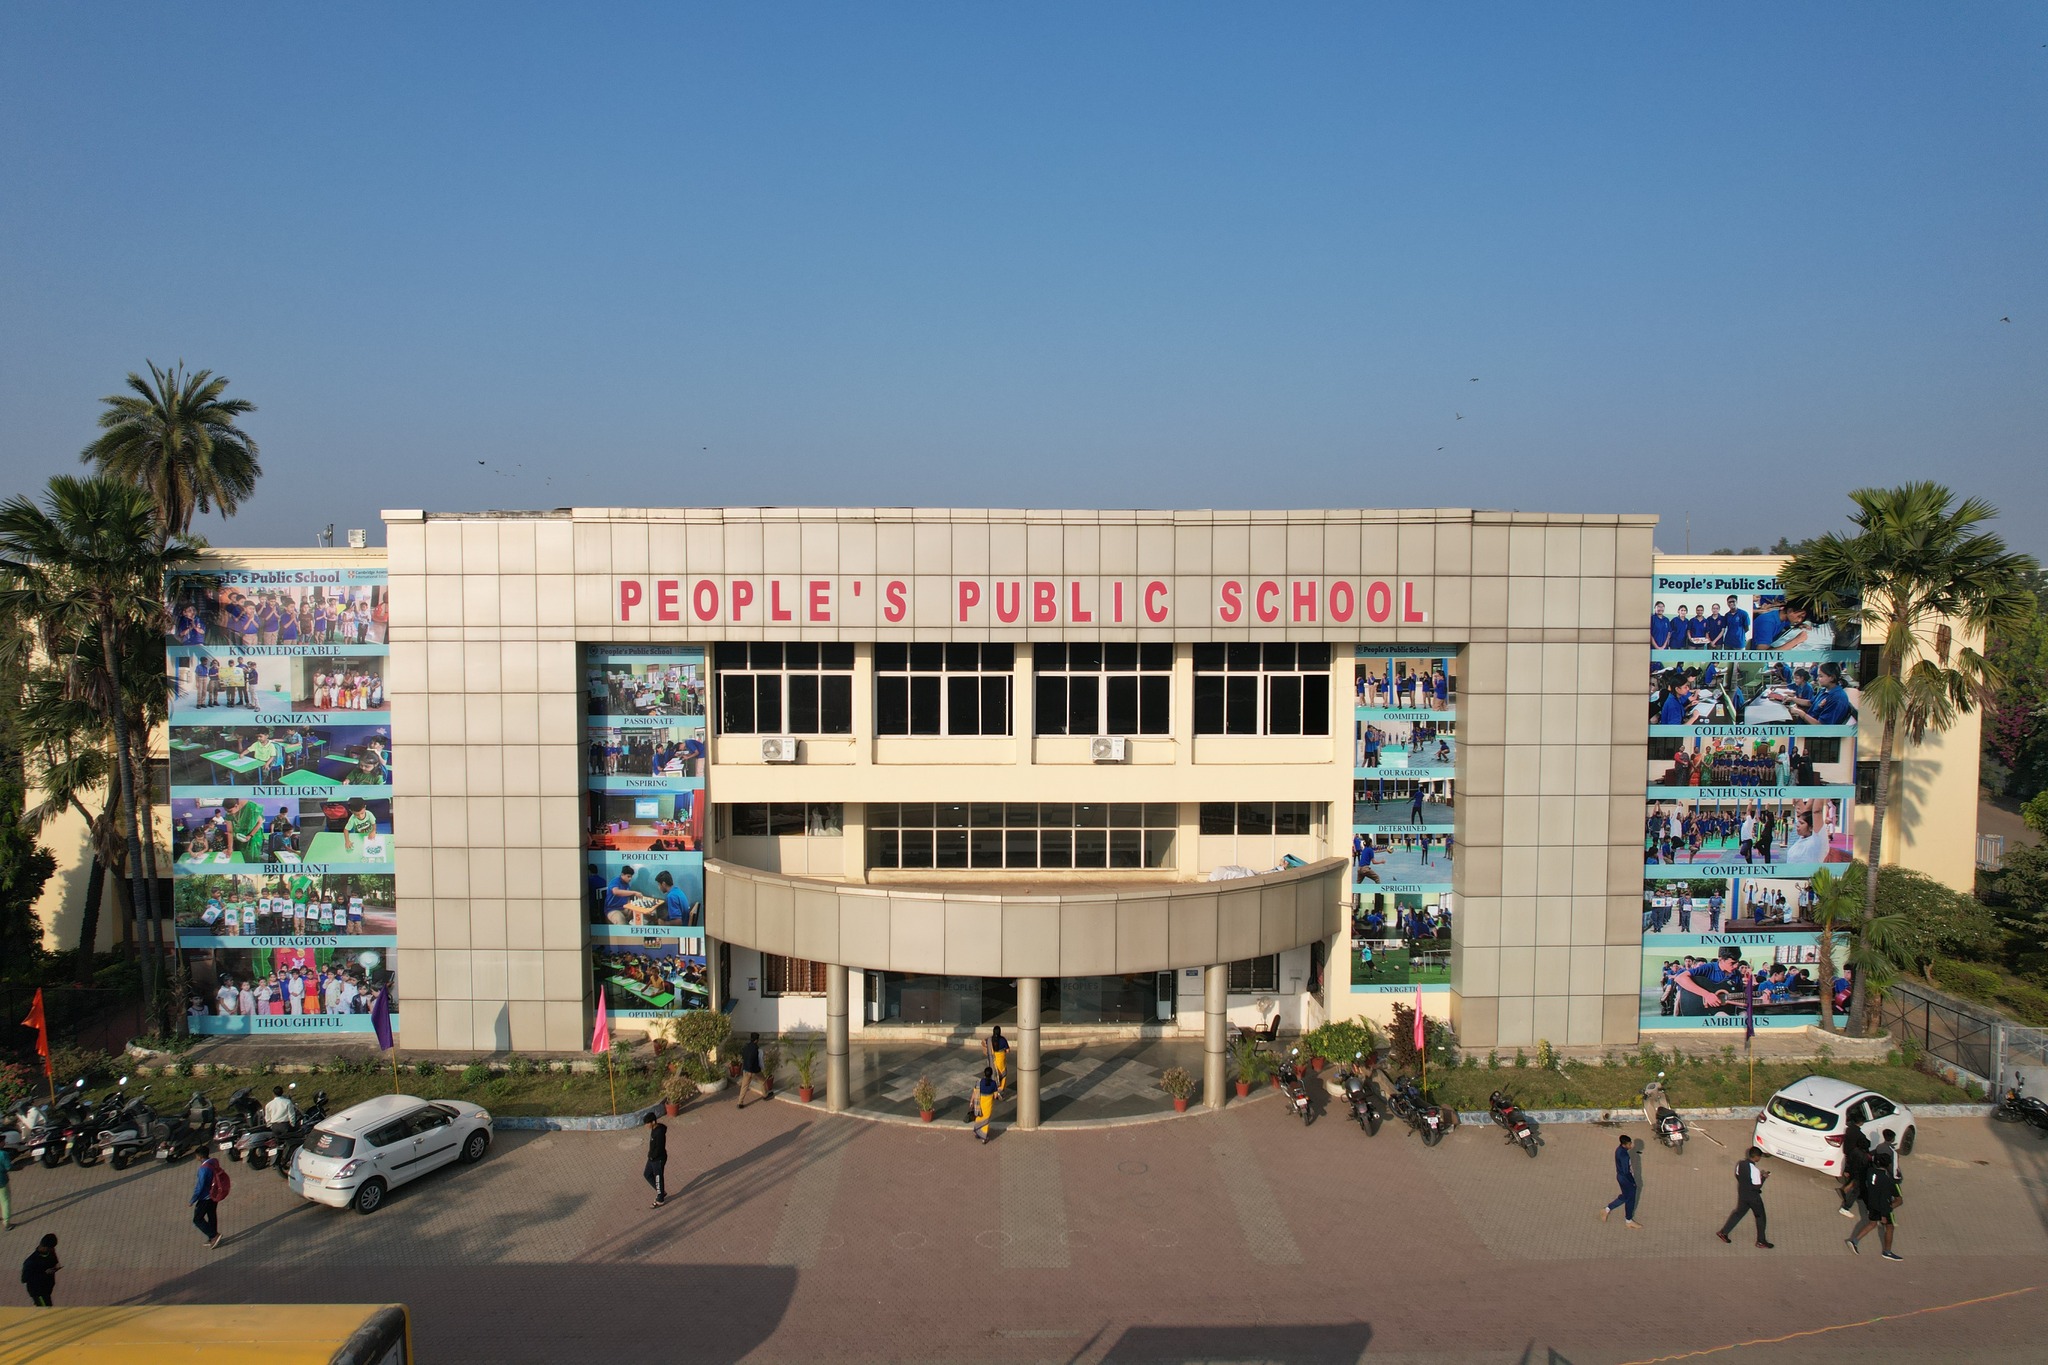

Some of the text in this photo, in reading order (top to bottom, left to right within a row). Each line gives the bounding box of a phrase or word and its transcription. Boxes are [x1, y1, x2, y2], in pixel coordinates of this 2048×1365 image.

[250, 571, 292, 584] Public
[294, 571, 340, 583] School
[1659, 578, 1713, 592] People's
[1714, 578, 1755, 590] Public
[620, 579, 1428, 622] PEOPLE'S PUBLIC SCHOOL
[229, 646, 341, 656] KNOWLEDGEABLE
[600, 647, 628, 656] People's
[629, 647, 649, 655] Public
[650, 647, 672, 655] School
[1363, 646, 1389, 655] People's
[1711, 651, 1784, 661] REFLECTIVE
[255, 714, 329, 724] COGNIZANT
[1694, 726, 1795, 736] COLLABORATIVE
[626, 779, 668, 787] INSPIRING
[252, 786, 335, 796] INTELLIGENT
[1699, 788, 1786, 798] ENTHUSIASTIC
[621, 853, 670, 861] PROFICIENT
[263, 864, 329, 874] BRILLIANT
[1702, 866, 1777, 876] COMPETENT
[630, 927, 672, 935] EFFICIENT
[251, 936, 338, 946] COURAGEOUS
[1700, 934, 1775, 944] INNOVATIVE
[256, 1017, 343, 1028] THOUGHTFUL
